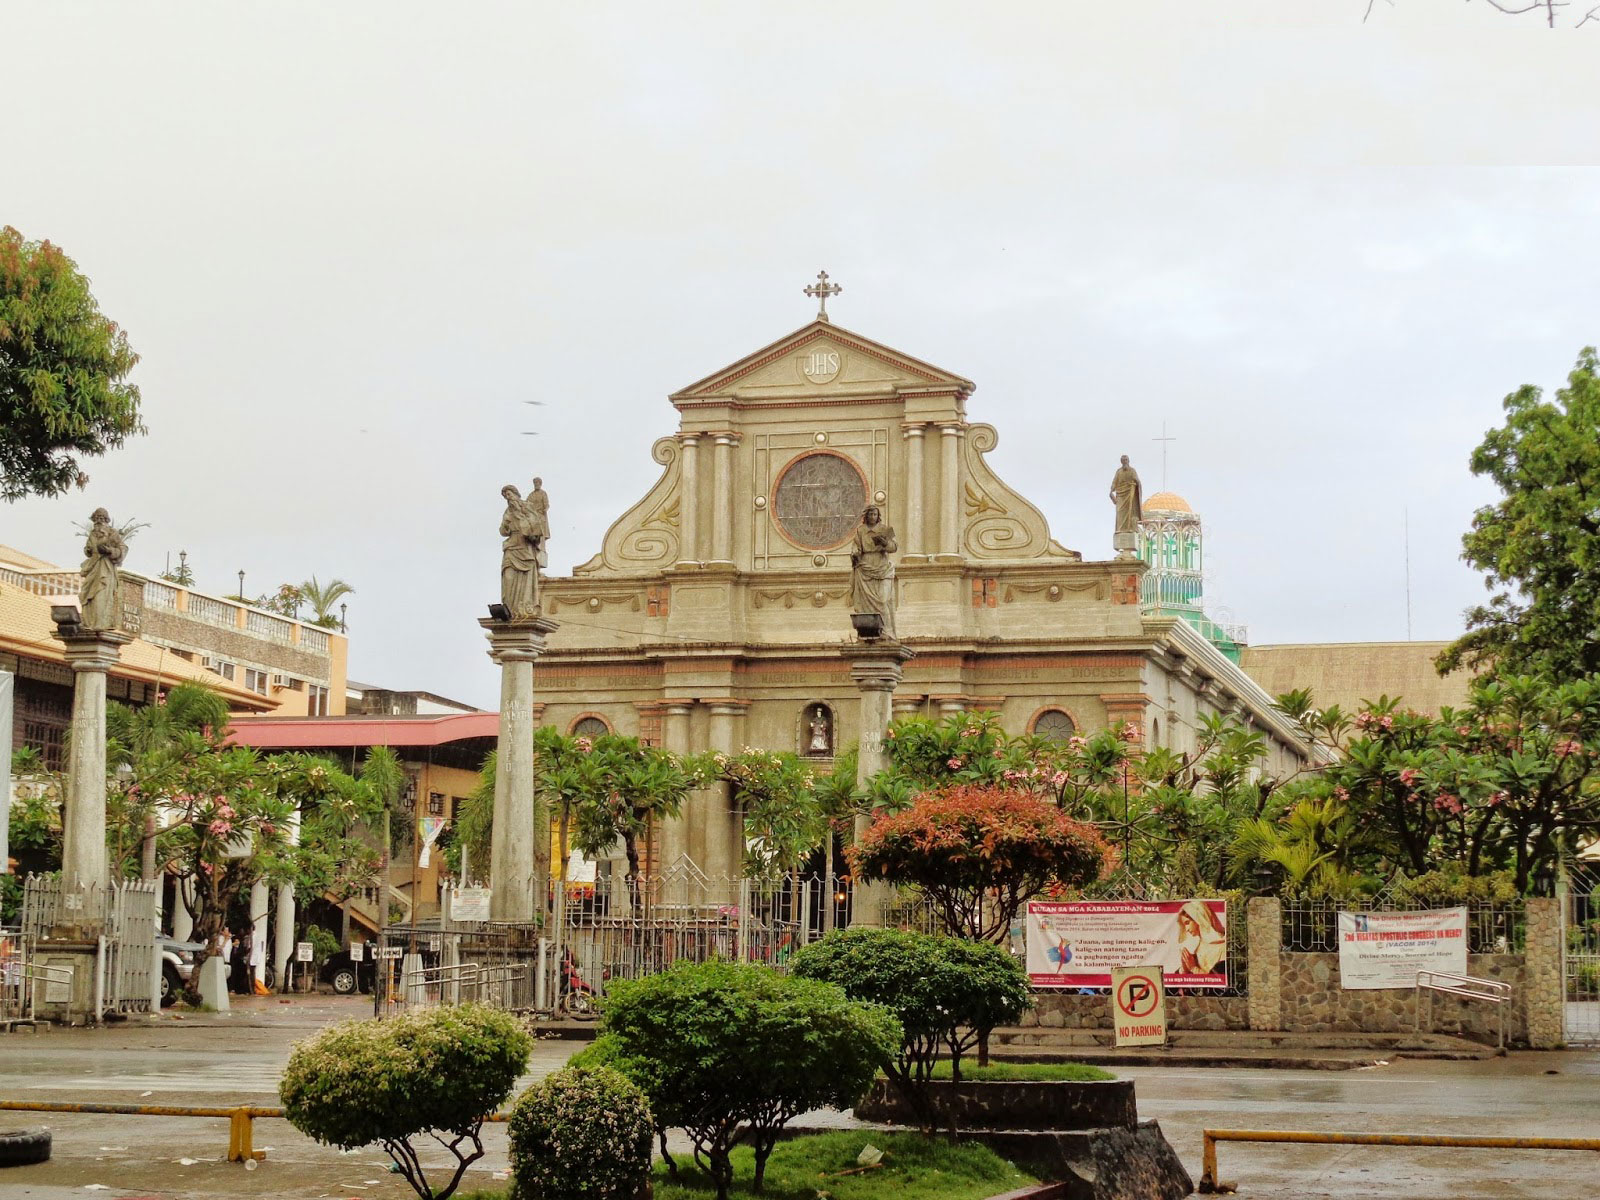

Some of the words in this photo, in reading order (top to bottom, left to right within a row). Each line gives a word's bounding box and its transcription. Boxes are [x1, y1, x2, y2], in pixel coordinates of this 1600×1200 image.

[804, 352, 839, 376] JHS
[1071, 667, 1126, 679] DIOCESE
[1344, 932, 1355, 941] 2nd
[1445, 928, 1463, 938] MERCY
[1120, 1026, 1130, 1037] NO
[1131, 1025, 1162, 1037] PARKING
